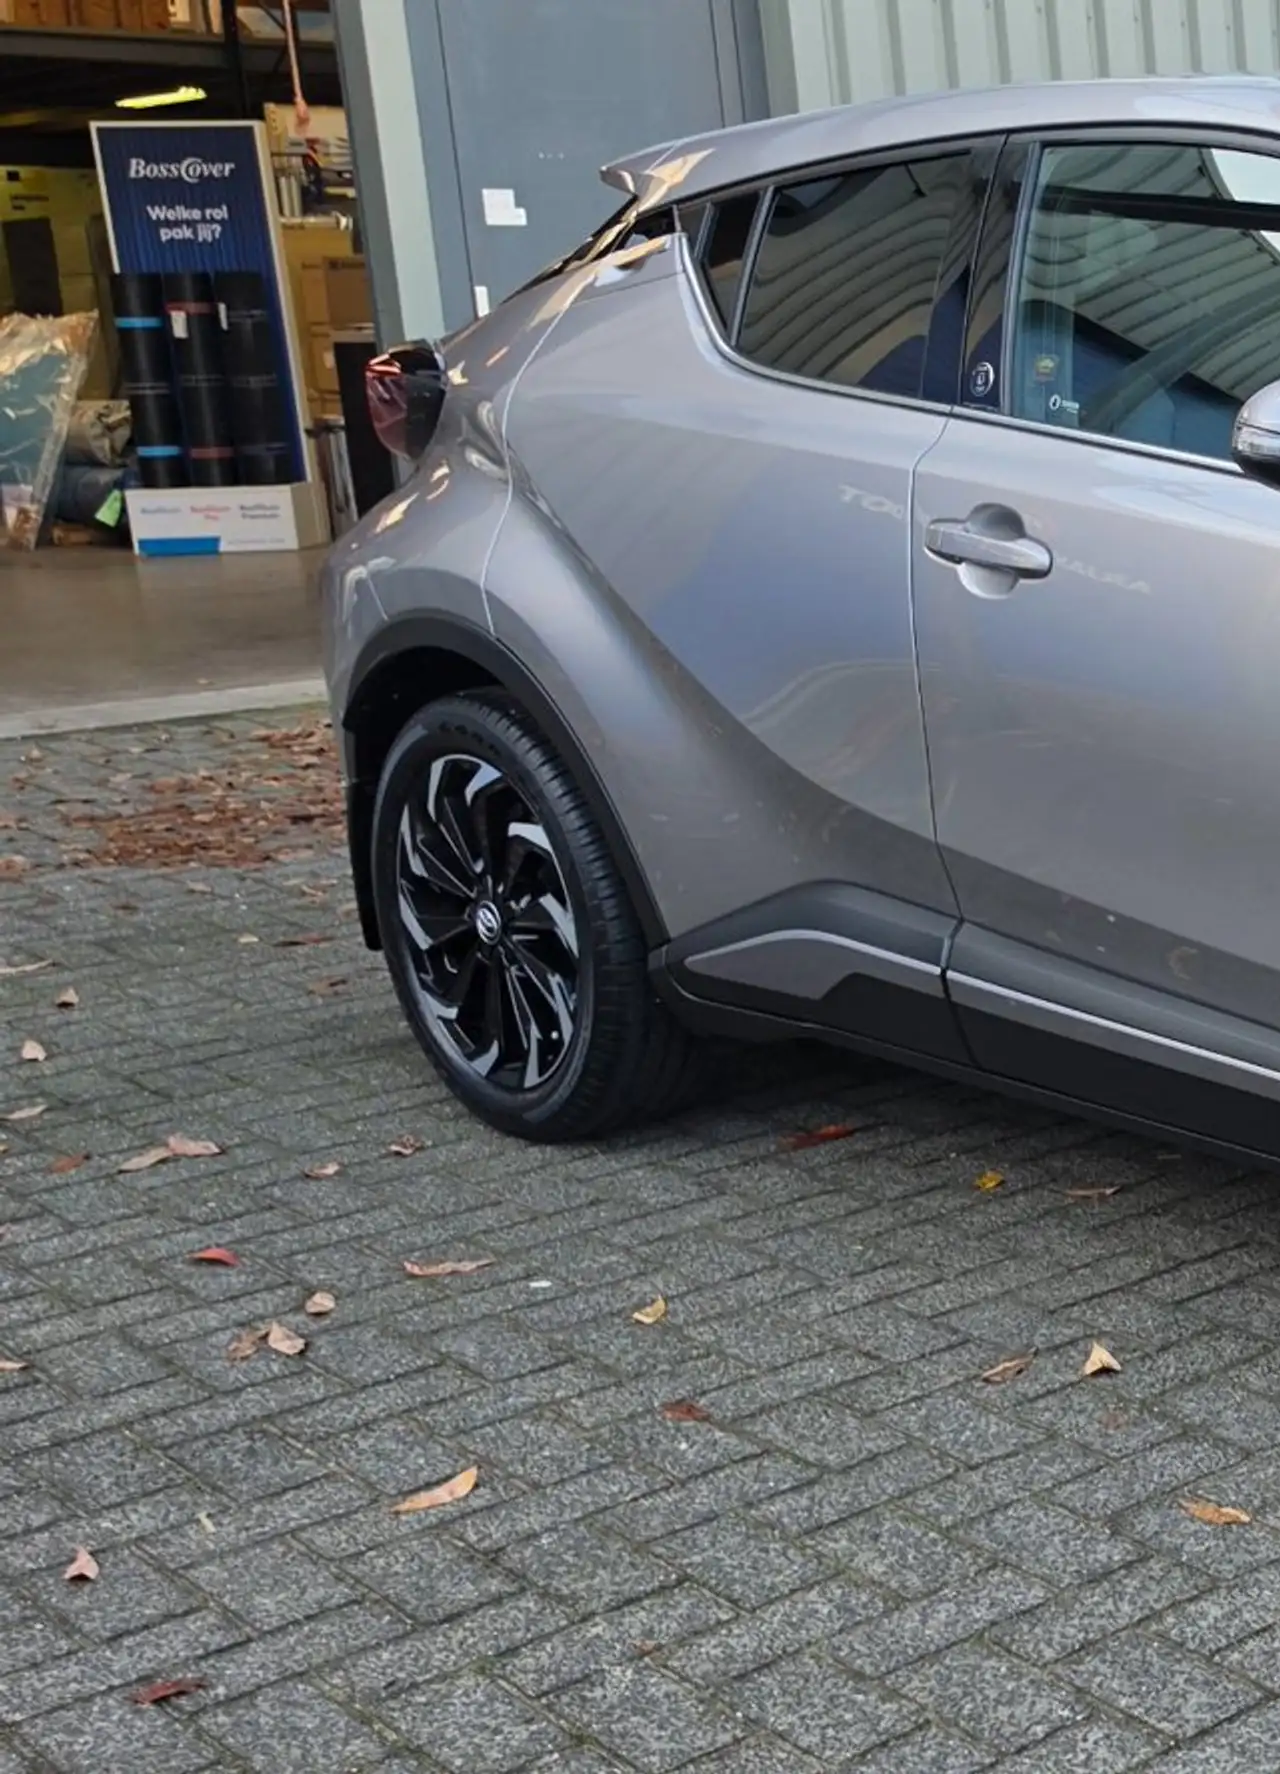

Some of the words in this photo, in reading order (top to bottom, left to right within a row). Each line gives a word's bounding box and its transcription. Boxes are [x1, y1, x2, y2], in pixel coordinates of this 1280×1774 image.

[128, 157, 236, 184] BossCover
[146, 204, 202, 220] Welke
[204, 203, 229, 220] rol
[160, 225, 194, 242] pak
[196, 222, 222, 242] jij?
